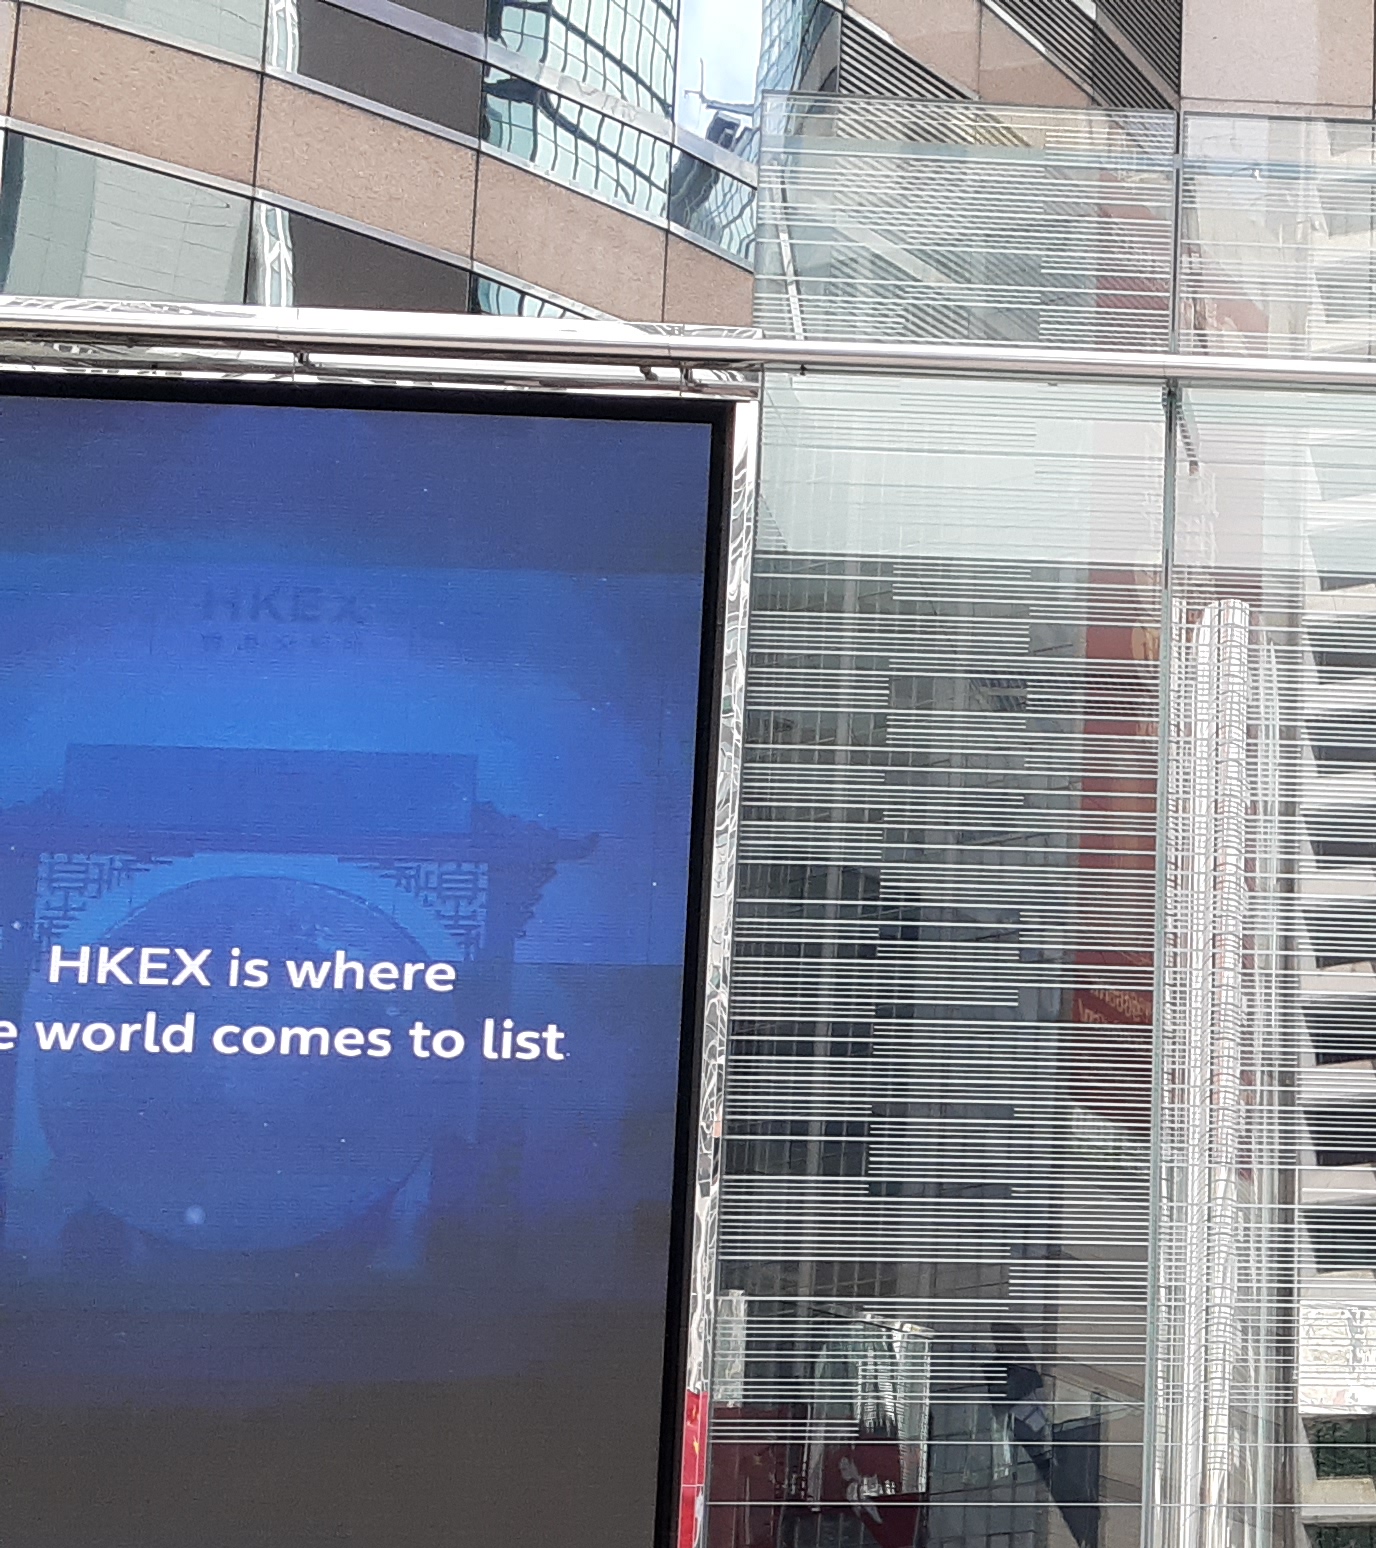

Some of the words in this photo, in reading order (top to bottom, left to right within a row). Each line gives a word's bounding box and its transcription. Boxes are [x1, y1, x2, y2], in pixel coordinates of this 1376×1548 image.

[49, 945, 212, 986] HKEX
[229, 947, 269, 988] is
[285, 950, 456, 992] where
[35, 1011, 195, 1053] world
[212, 1025, 392, 1057] comes
[408, 1021, 465, 1059] to
